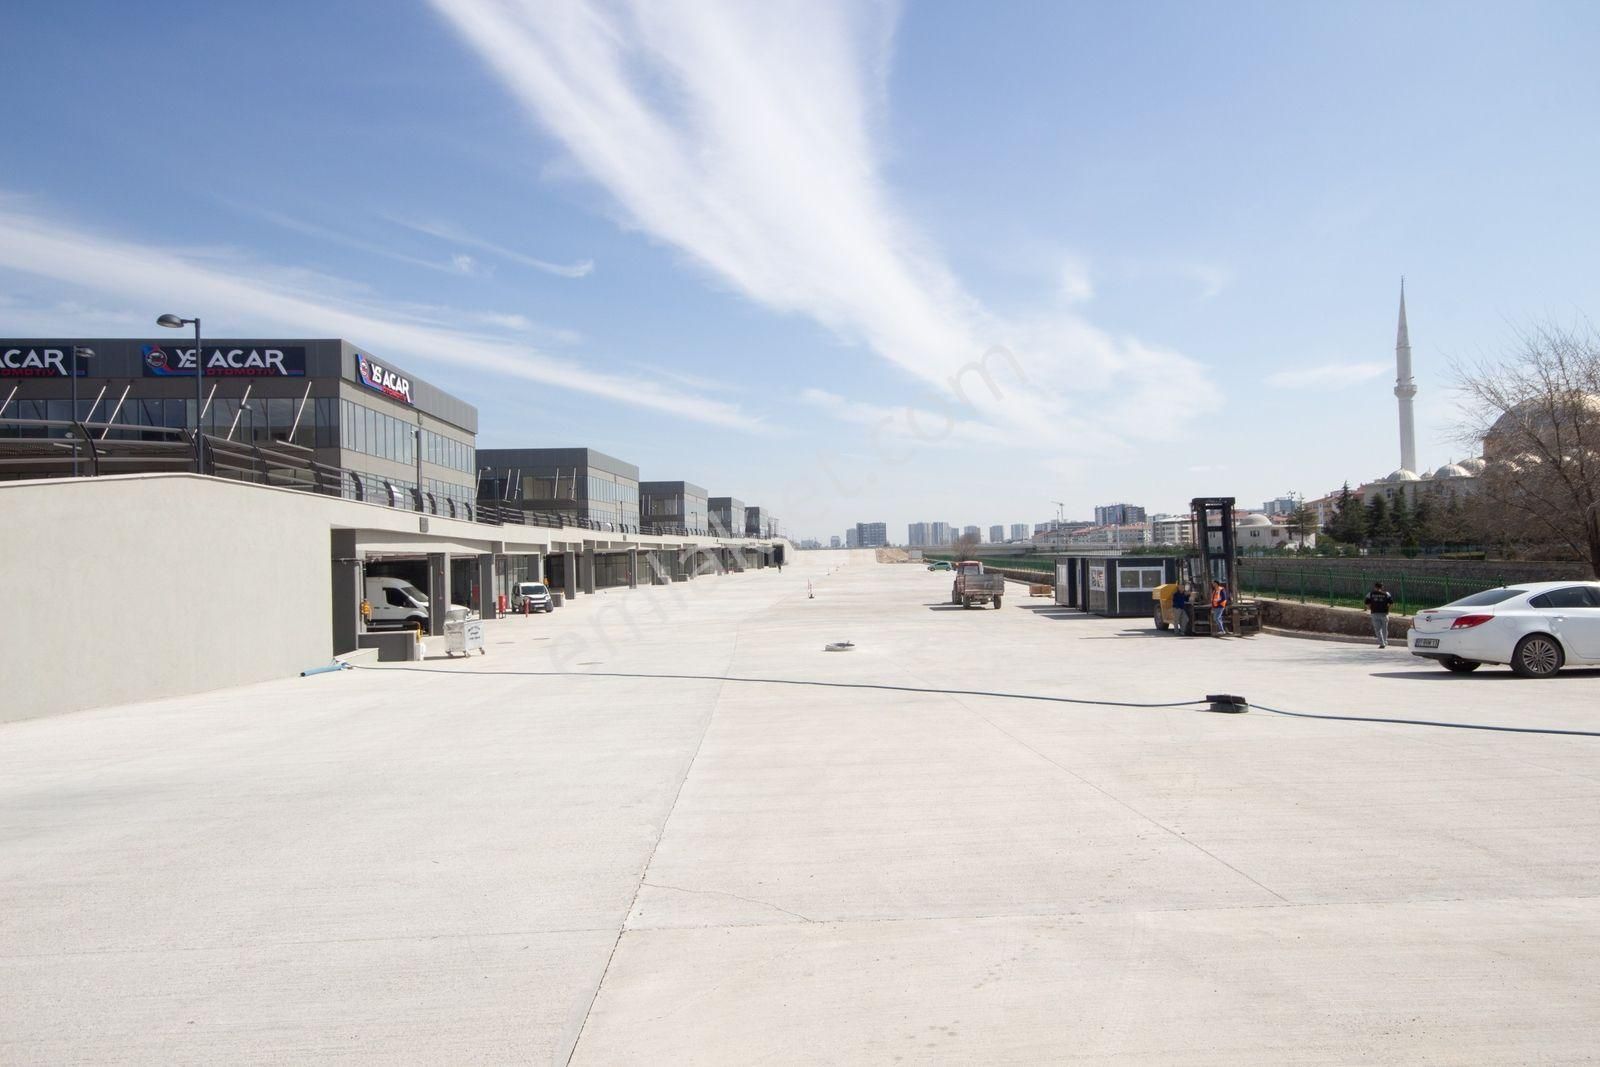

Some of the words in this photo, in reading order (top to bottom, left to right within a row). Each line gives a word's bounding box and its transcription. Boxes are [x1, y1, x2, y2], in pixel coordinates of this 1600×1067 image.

[0, 349, 68, 376] CAR
[207, 349, 288, 376] ACAR
[207, 368, 275, 376] OTOMOTIV
[371, 363, 382, 384] YS
[382, 370, 411, 403] ACAR
